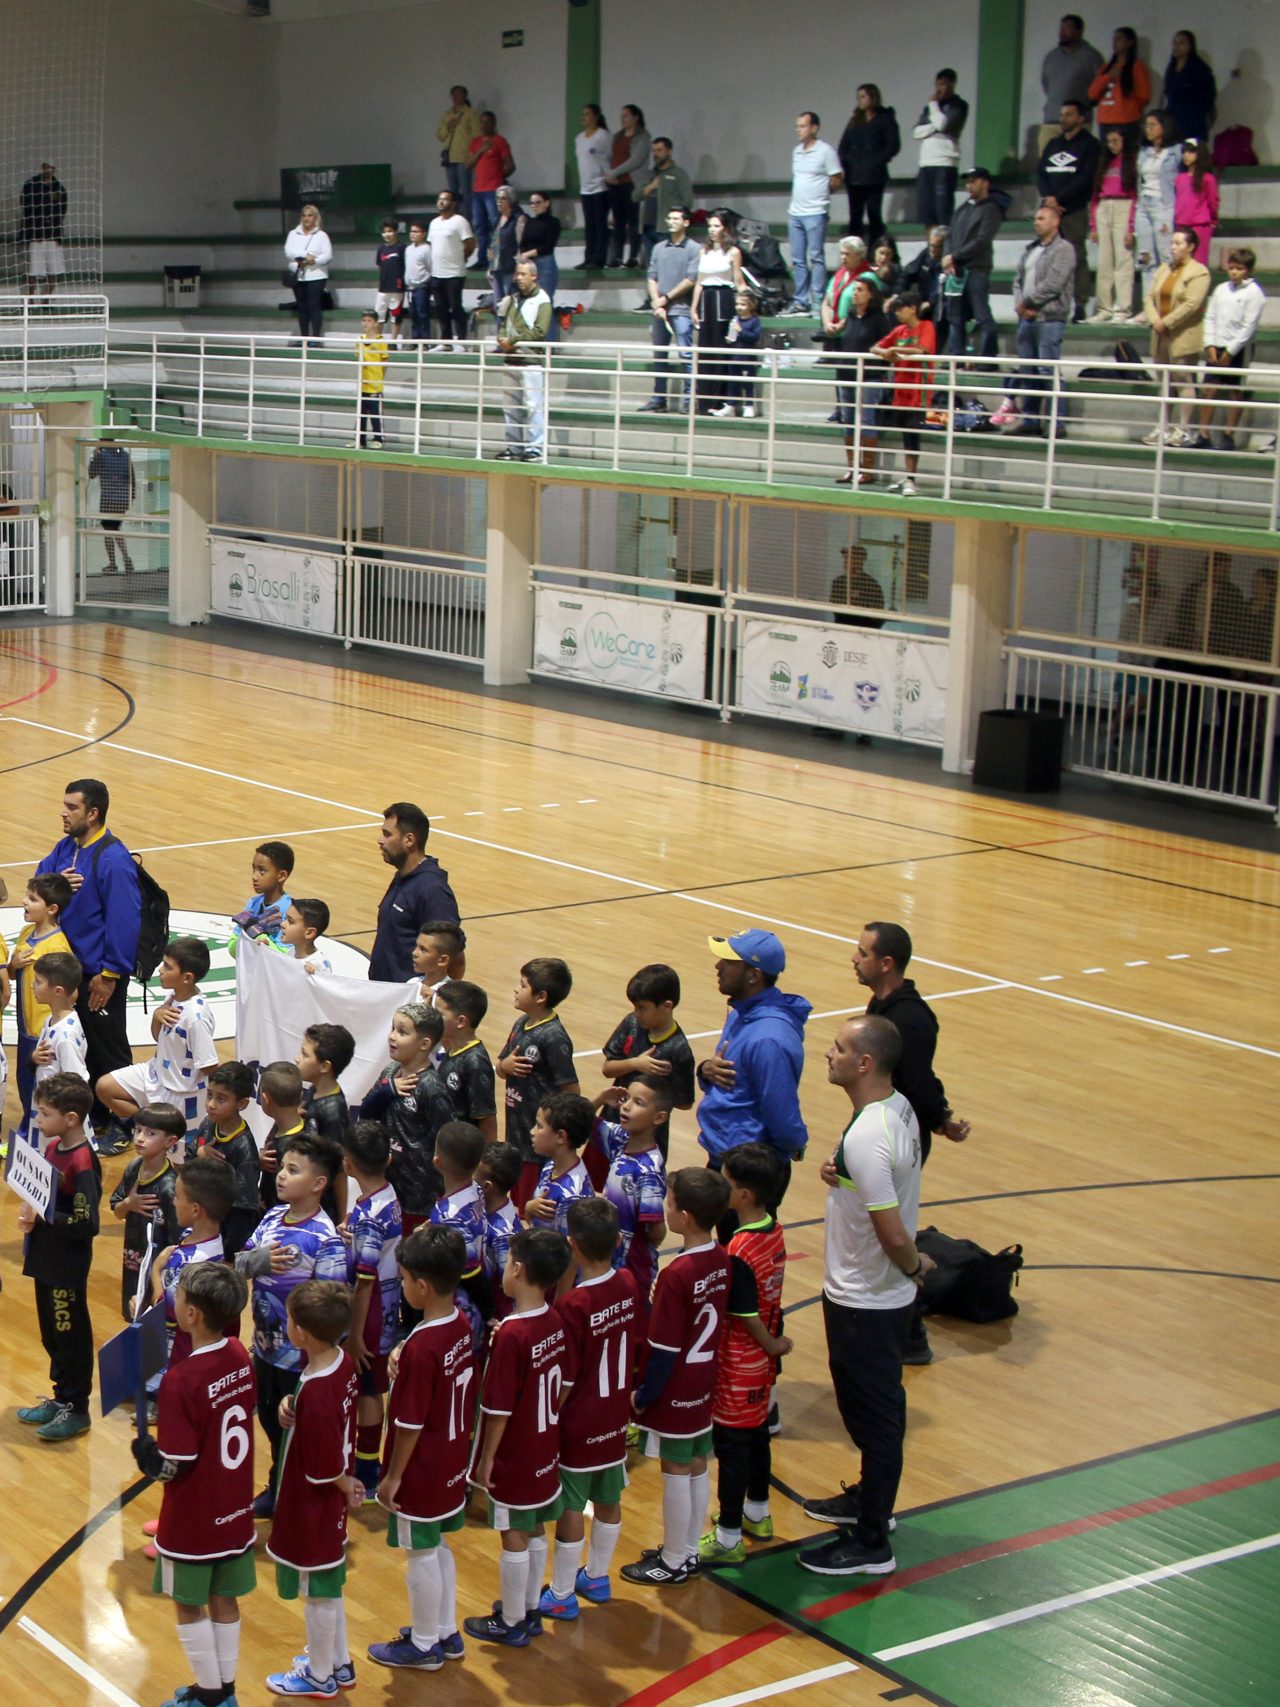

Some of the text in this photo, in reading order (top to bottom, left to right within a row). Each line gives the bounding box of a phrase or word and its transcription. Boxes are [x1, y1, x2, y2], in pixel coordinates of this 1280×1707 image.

[591, 628, 656, 660] WeCare
[53, 1288, 72, 1332] SACS
[590, 1302, 621, 1328] BATE
[686, 1303, 718, 1364] 2
[532, 1333, 557, 1359] BATE
[599, 1331, 627, 1398] 11
[207, 1370, 238, 1399] BATE
[448, 1366, 474, 1442] 17
[538, 1364, 562, 1433] 10
[221, 1404, 250, 1470] 6
